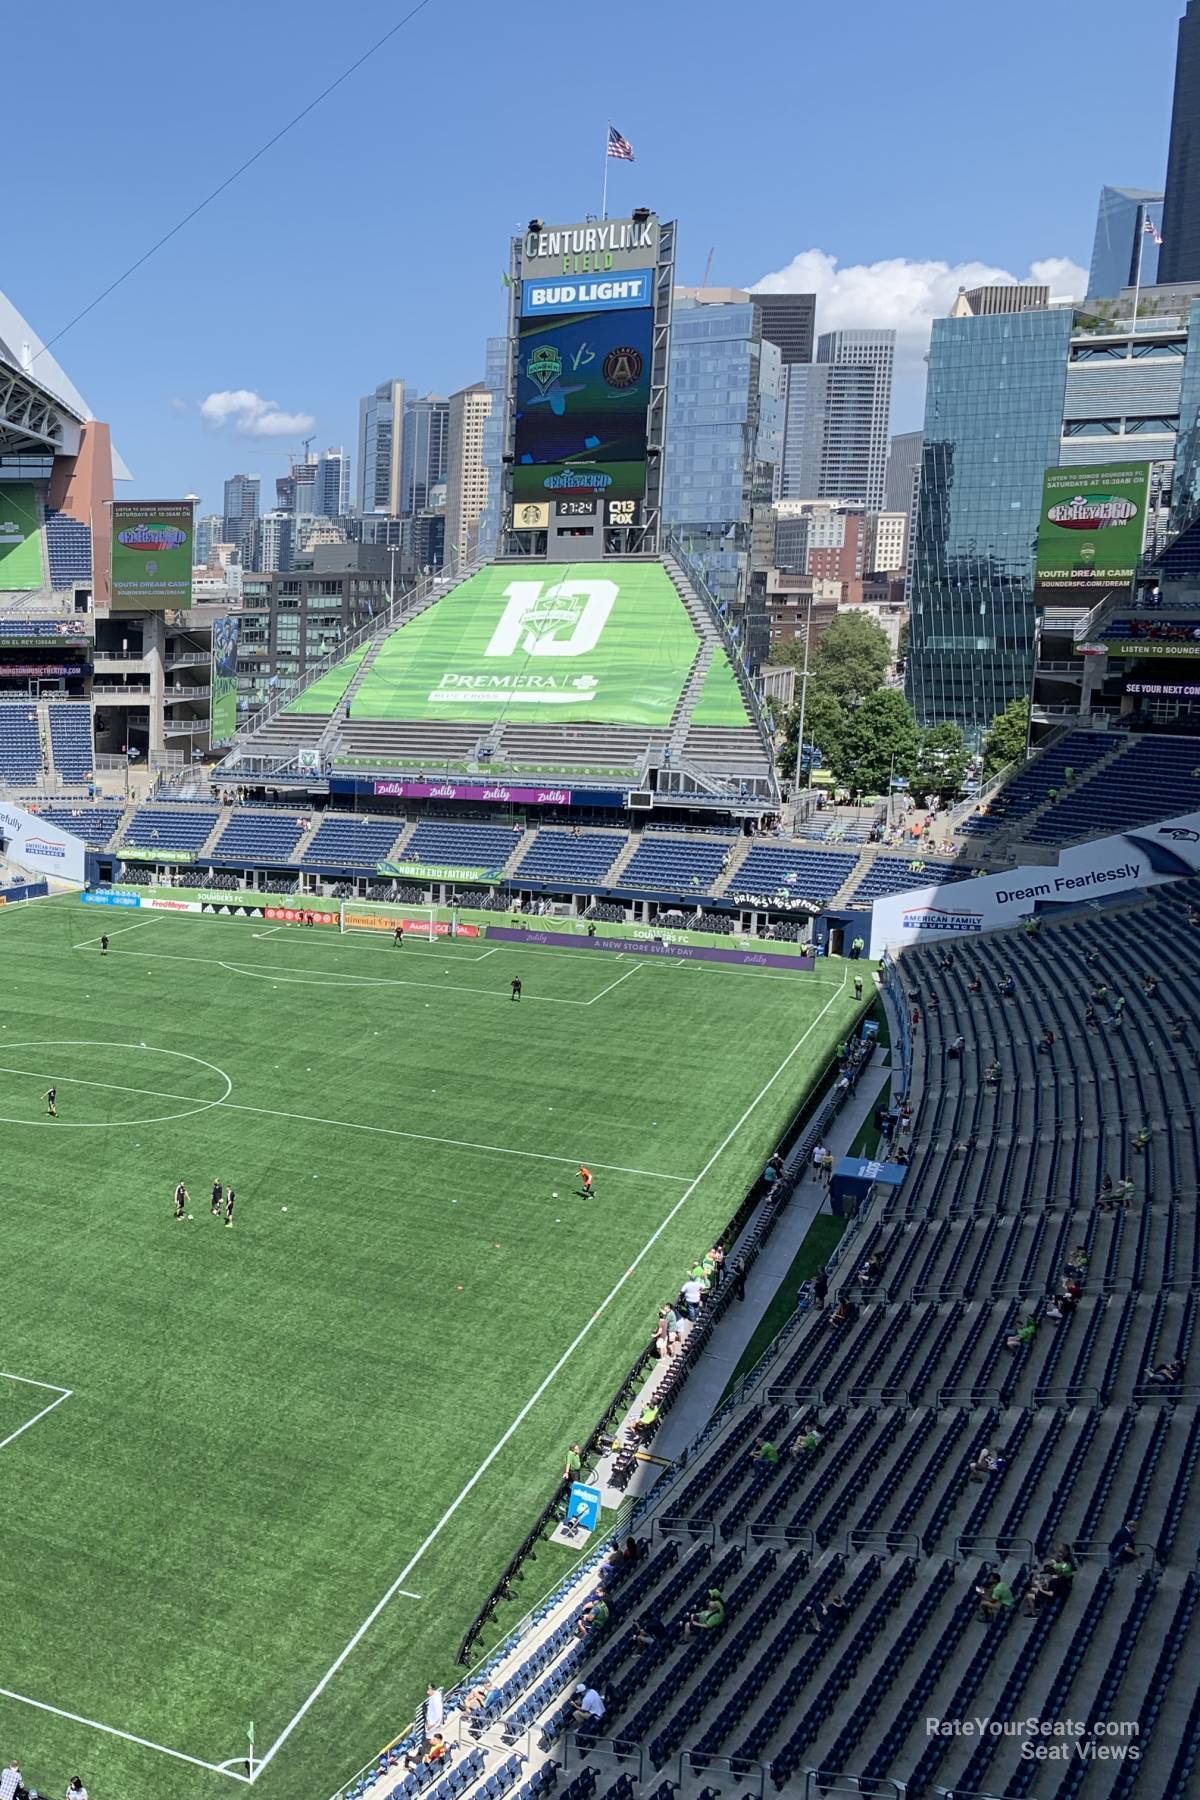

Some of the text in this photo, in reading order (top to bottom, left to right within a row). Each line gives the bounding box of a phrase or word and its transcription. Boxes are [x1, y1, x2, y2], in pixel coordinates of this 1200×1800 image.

[563, 253, 613, 273] FIELD
[532, 280, 642, 306] BUD LIGHT
[1047, 480, 1088, 489] SATURDAYS
[560, 500, 635, 514] 27:24 Q13
[1097, 503, 1131, 519] 1360
[609, 513, 633, 525] FOX
[1112, 518, 1127, 527] AM
[1038, 569, 1106, 579] YOUTH DREAM
[484, 579, 620, 657] 10
[437, 673, 563, 689] PREMERA
[1126, 684, 1140, 692] SEE
[1141, 685, 1161, 693] YOUR
[1163, 686, 1182, 694] NEXT
[399, 866, 479, 880] NORTH END FAITHFUL
[995, 864, 1141, 904] Dream Fearlessly
[198, 893, 233, 902] SOUNDERS
[904, 914, 983, 926] AMERICAN FAMILY
[624, 943, 648, 951] STORE
[651, 946, 675, 954] EVERY
[677, 948, 694, 956] DAY
